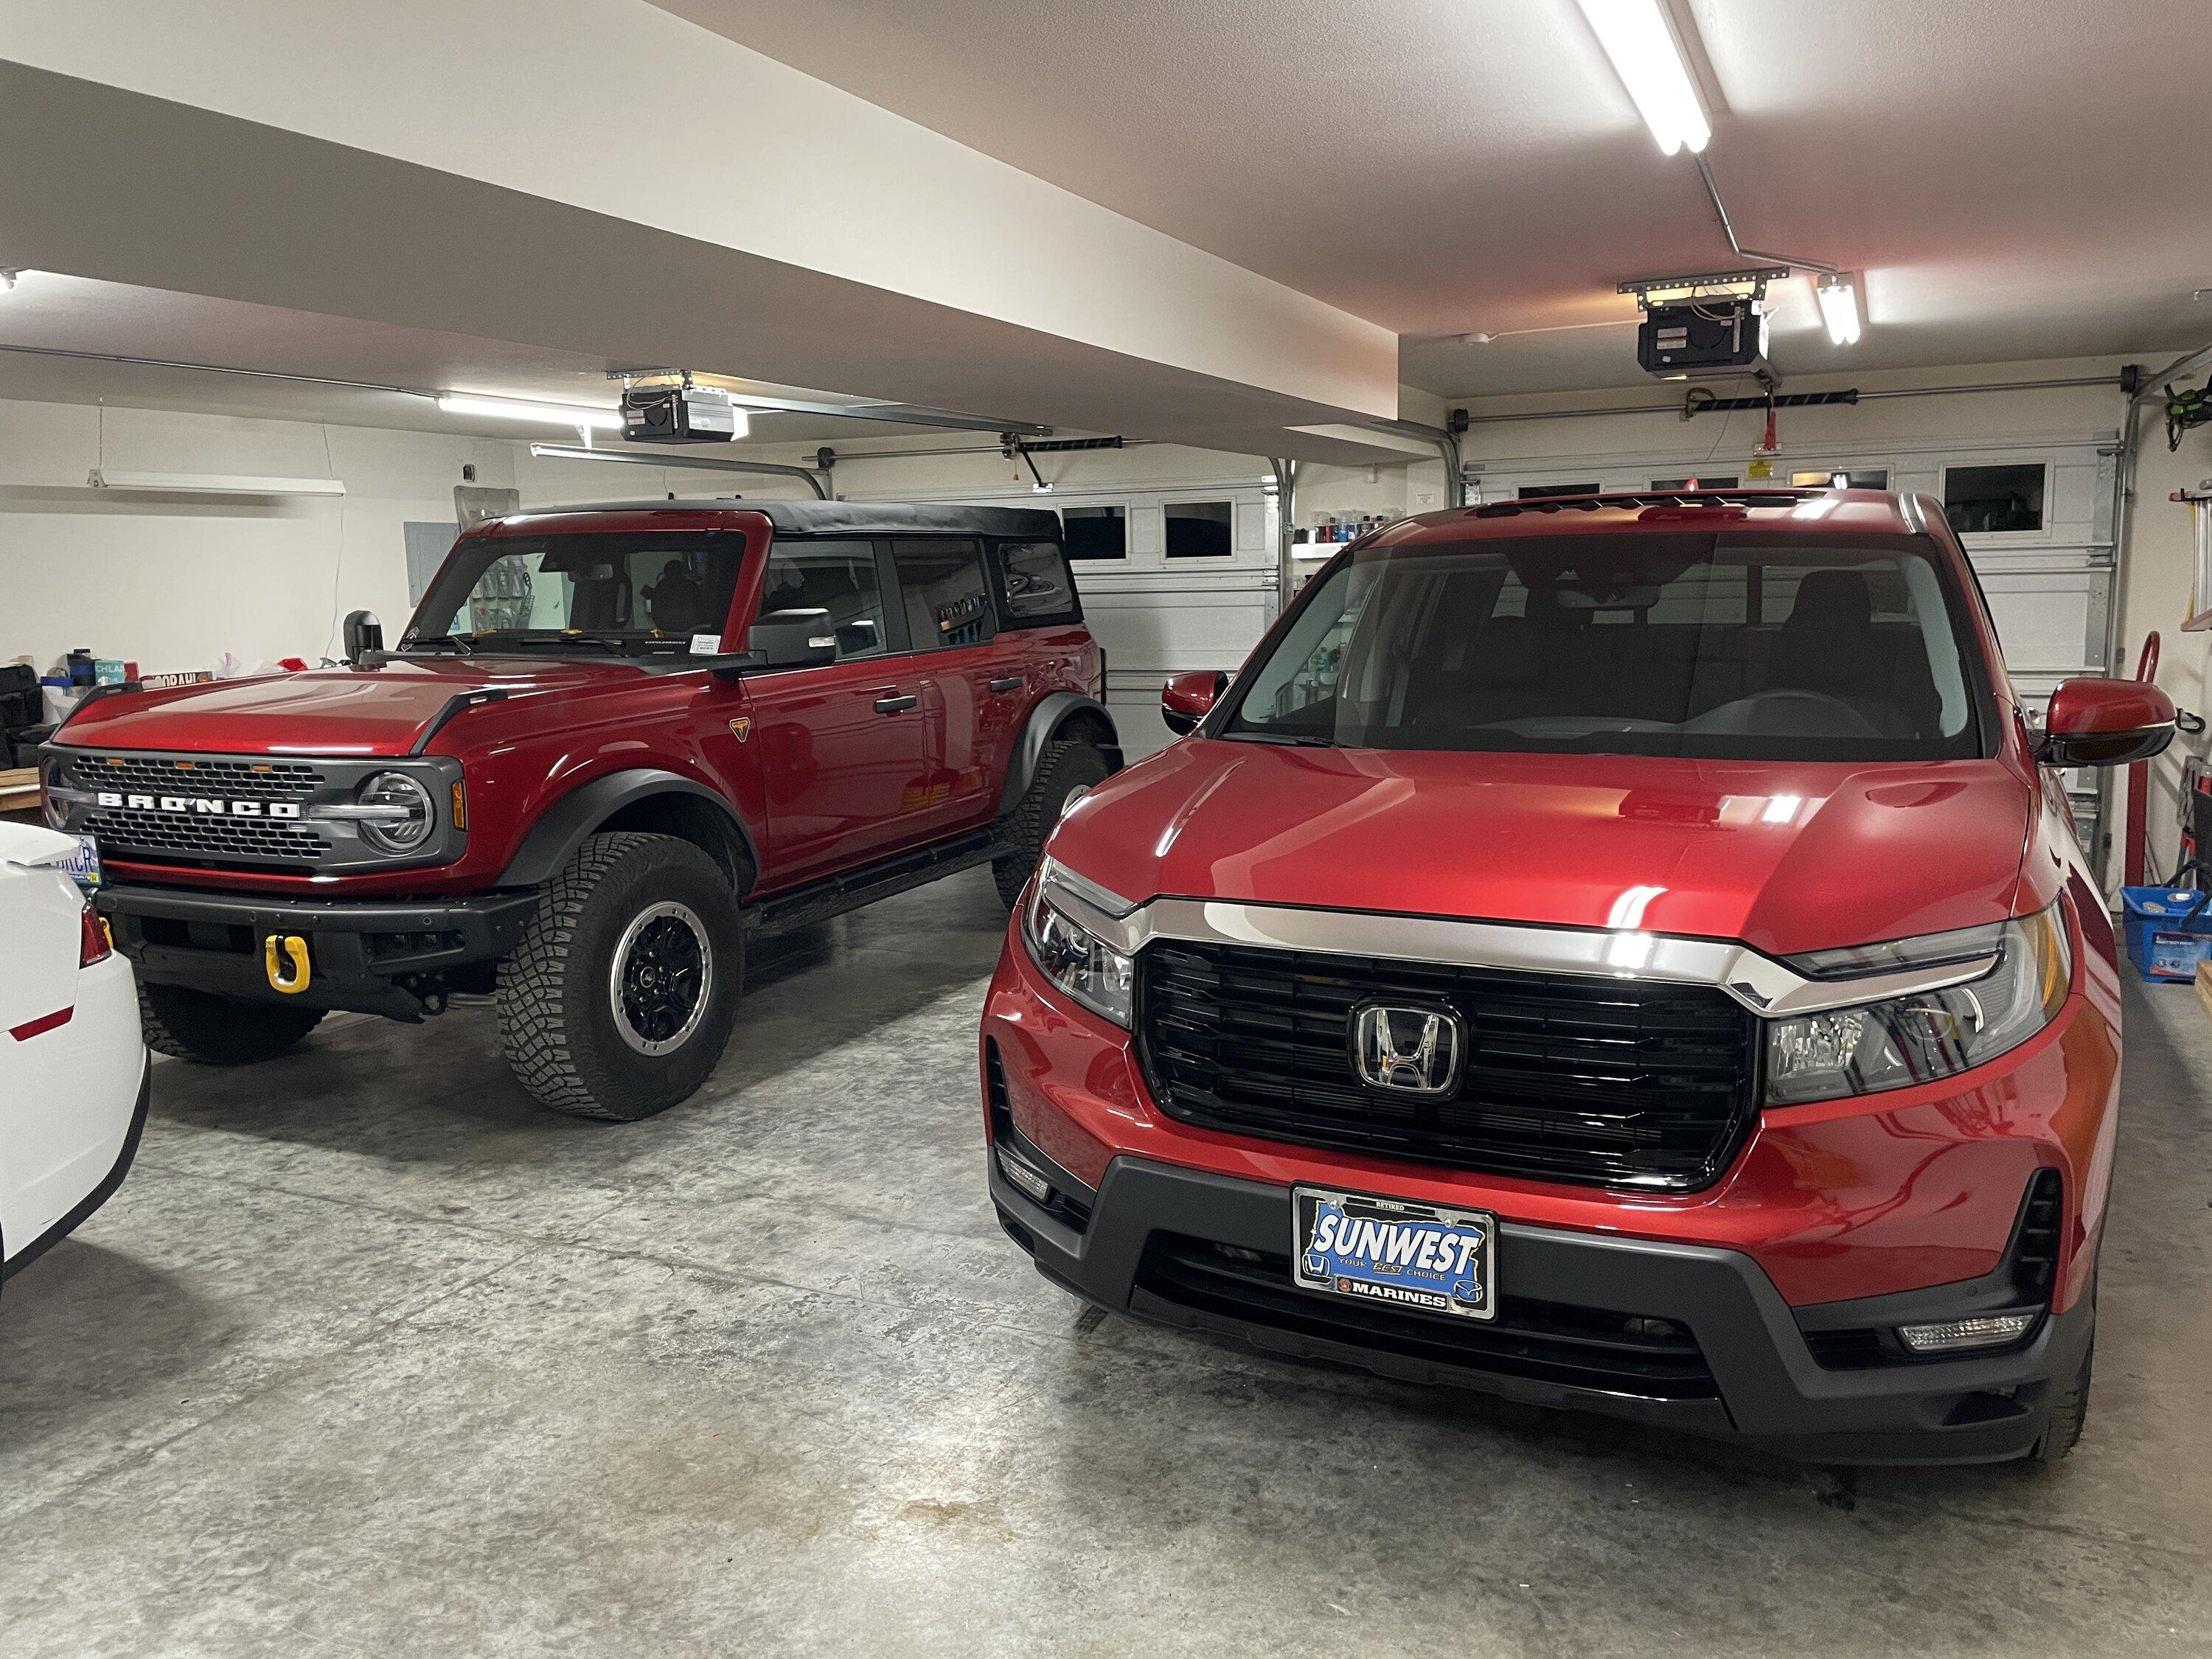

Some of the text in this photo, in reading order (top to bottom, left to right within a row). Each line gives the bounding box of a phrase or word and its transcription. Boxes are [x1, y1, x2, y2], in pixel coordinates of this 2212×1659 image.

[98, 793, 300, 818] BRONCO
[1376, 1201, 1405, 1211] RETIRED
[1313, 1214, 1479, 1274] SUNWEST
[1338, 1257, 1446, 1281] YOUR BEST CHOICE
[1352, 1282, 1446, 1307] MARINES
